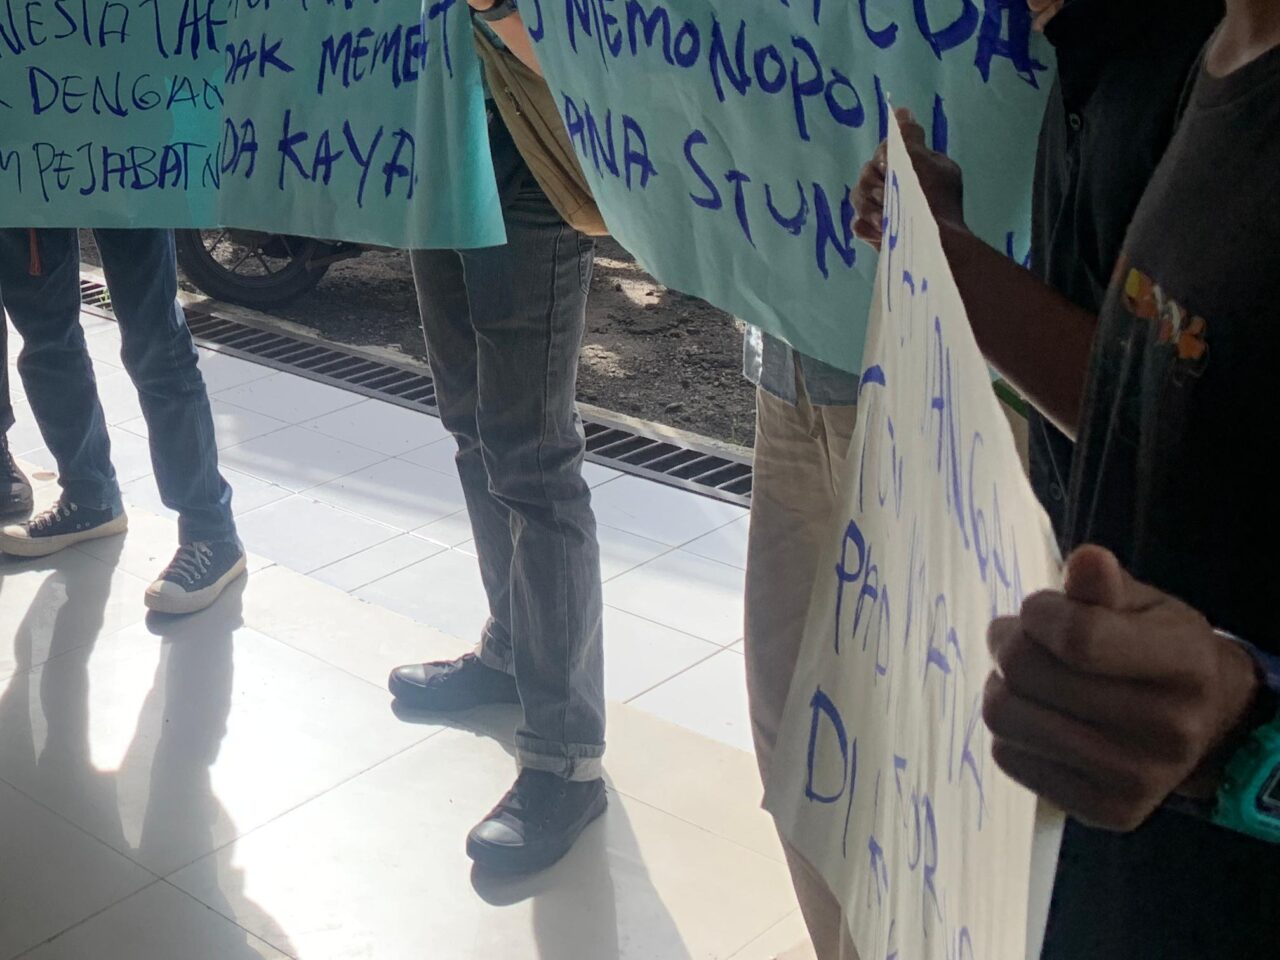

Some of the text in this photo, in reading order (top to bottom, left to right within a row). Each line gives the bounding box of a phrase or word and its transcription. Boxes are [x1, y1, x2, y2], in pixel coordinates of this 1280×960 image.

[32, 141, 208, 202] PEJABAT
[278, 109, 418, 208] KAYA
[561, 90, 858, 279] ANA STUN
